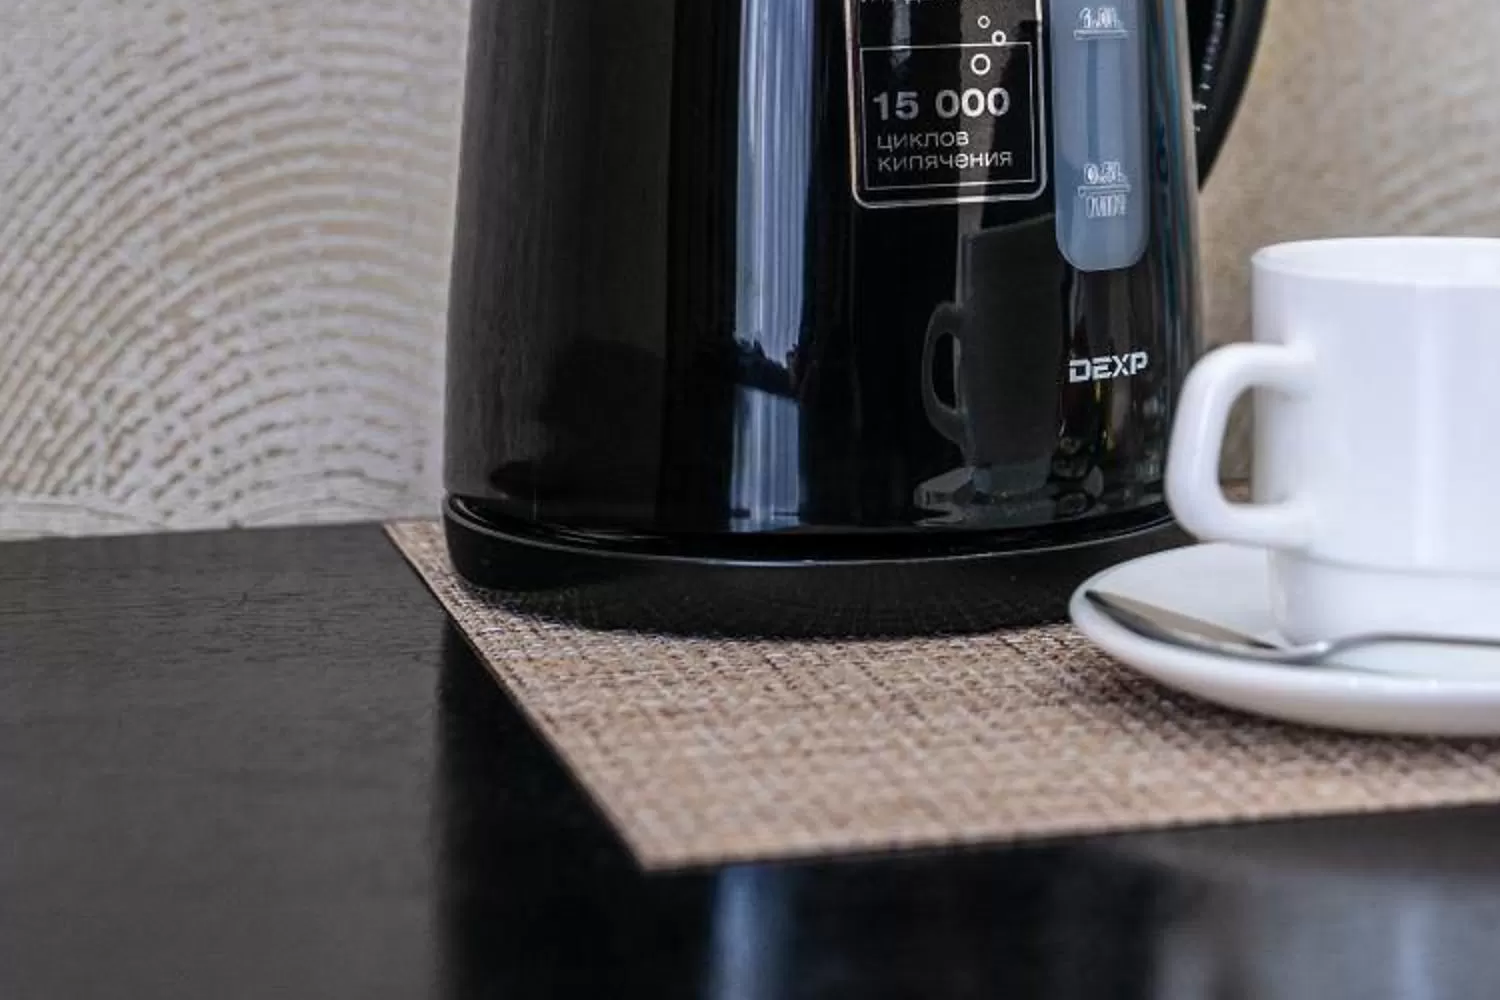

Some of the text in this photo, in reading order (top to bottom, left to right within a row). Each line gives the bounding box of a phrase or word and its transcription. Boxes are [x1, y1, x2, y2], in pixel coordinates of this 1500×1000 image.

[872, 87, 1010, 121] 15 000
[876, 131, 969, 150] ЦИКЛОВ
[877, 151, 1013, 172] КИПЯЧЕНИЯ
[1069, 351, 1149, 383] DEXP
